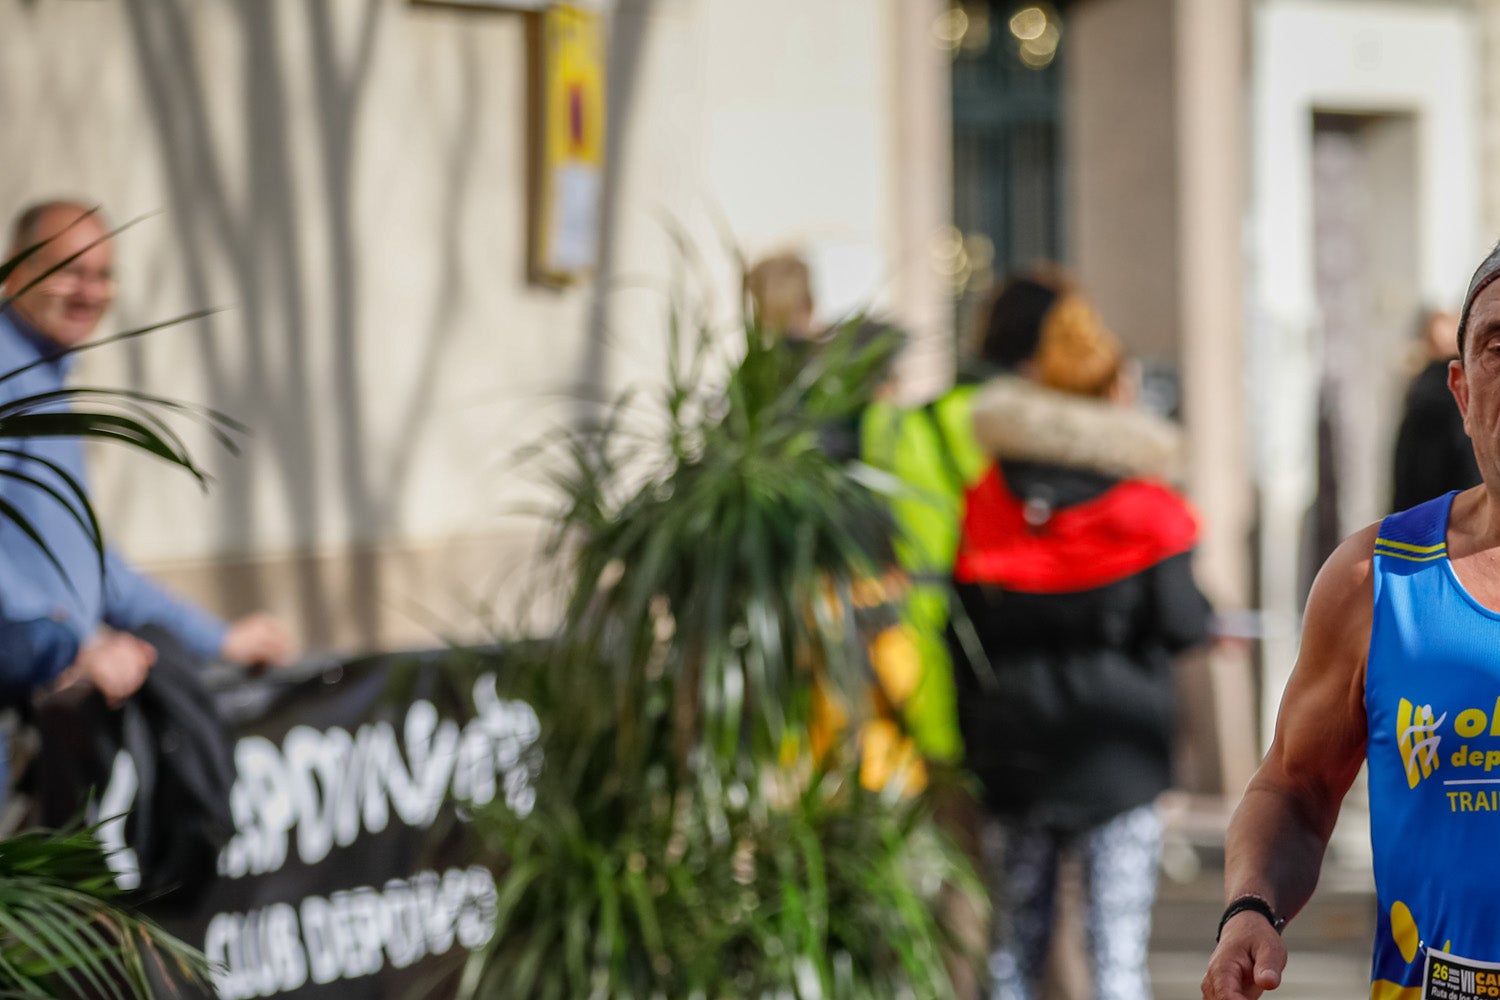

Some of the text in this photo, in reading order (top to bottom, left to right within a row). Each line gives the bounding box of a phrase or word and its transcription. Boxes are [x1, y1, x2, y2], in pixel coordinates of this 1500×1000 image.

[1432, 962, 1449, 981] 26
[1460, 968, 1476, 995] VII
[1431, 986, 1448, 1000] Ruta
